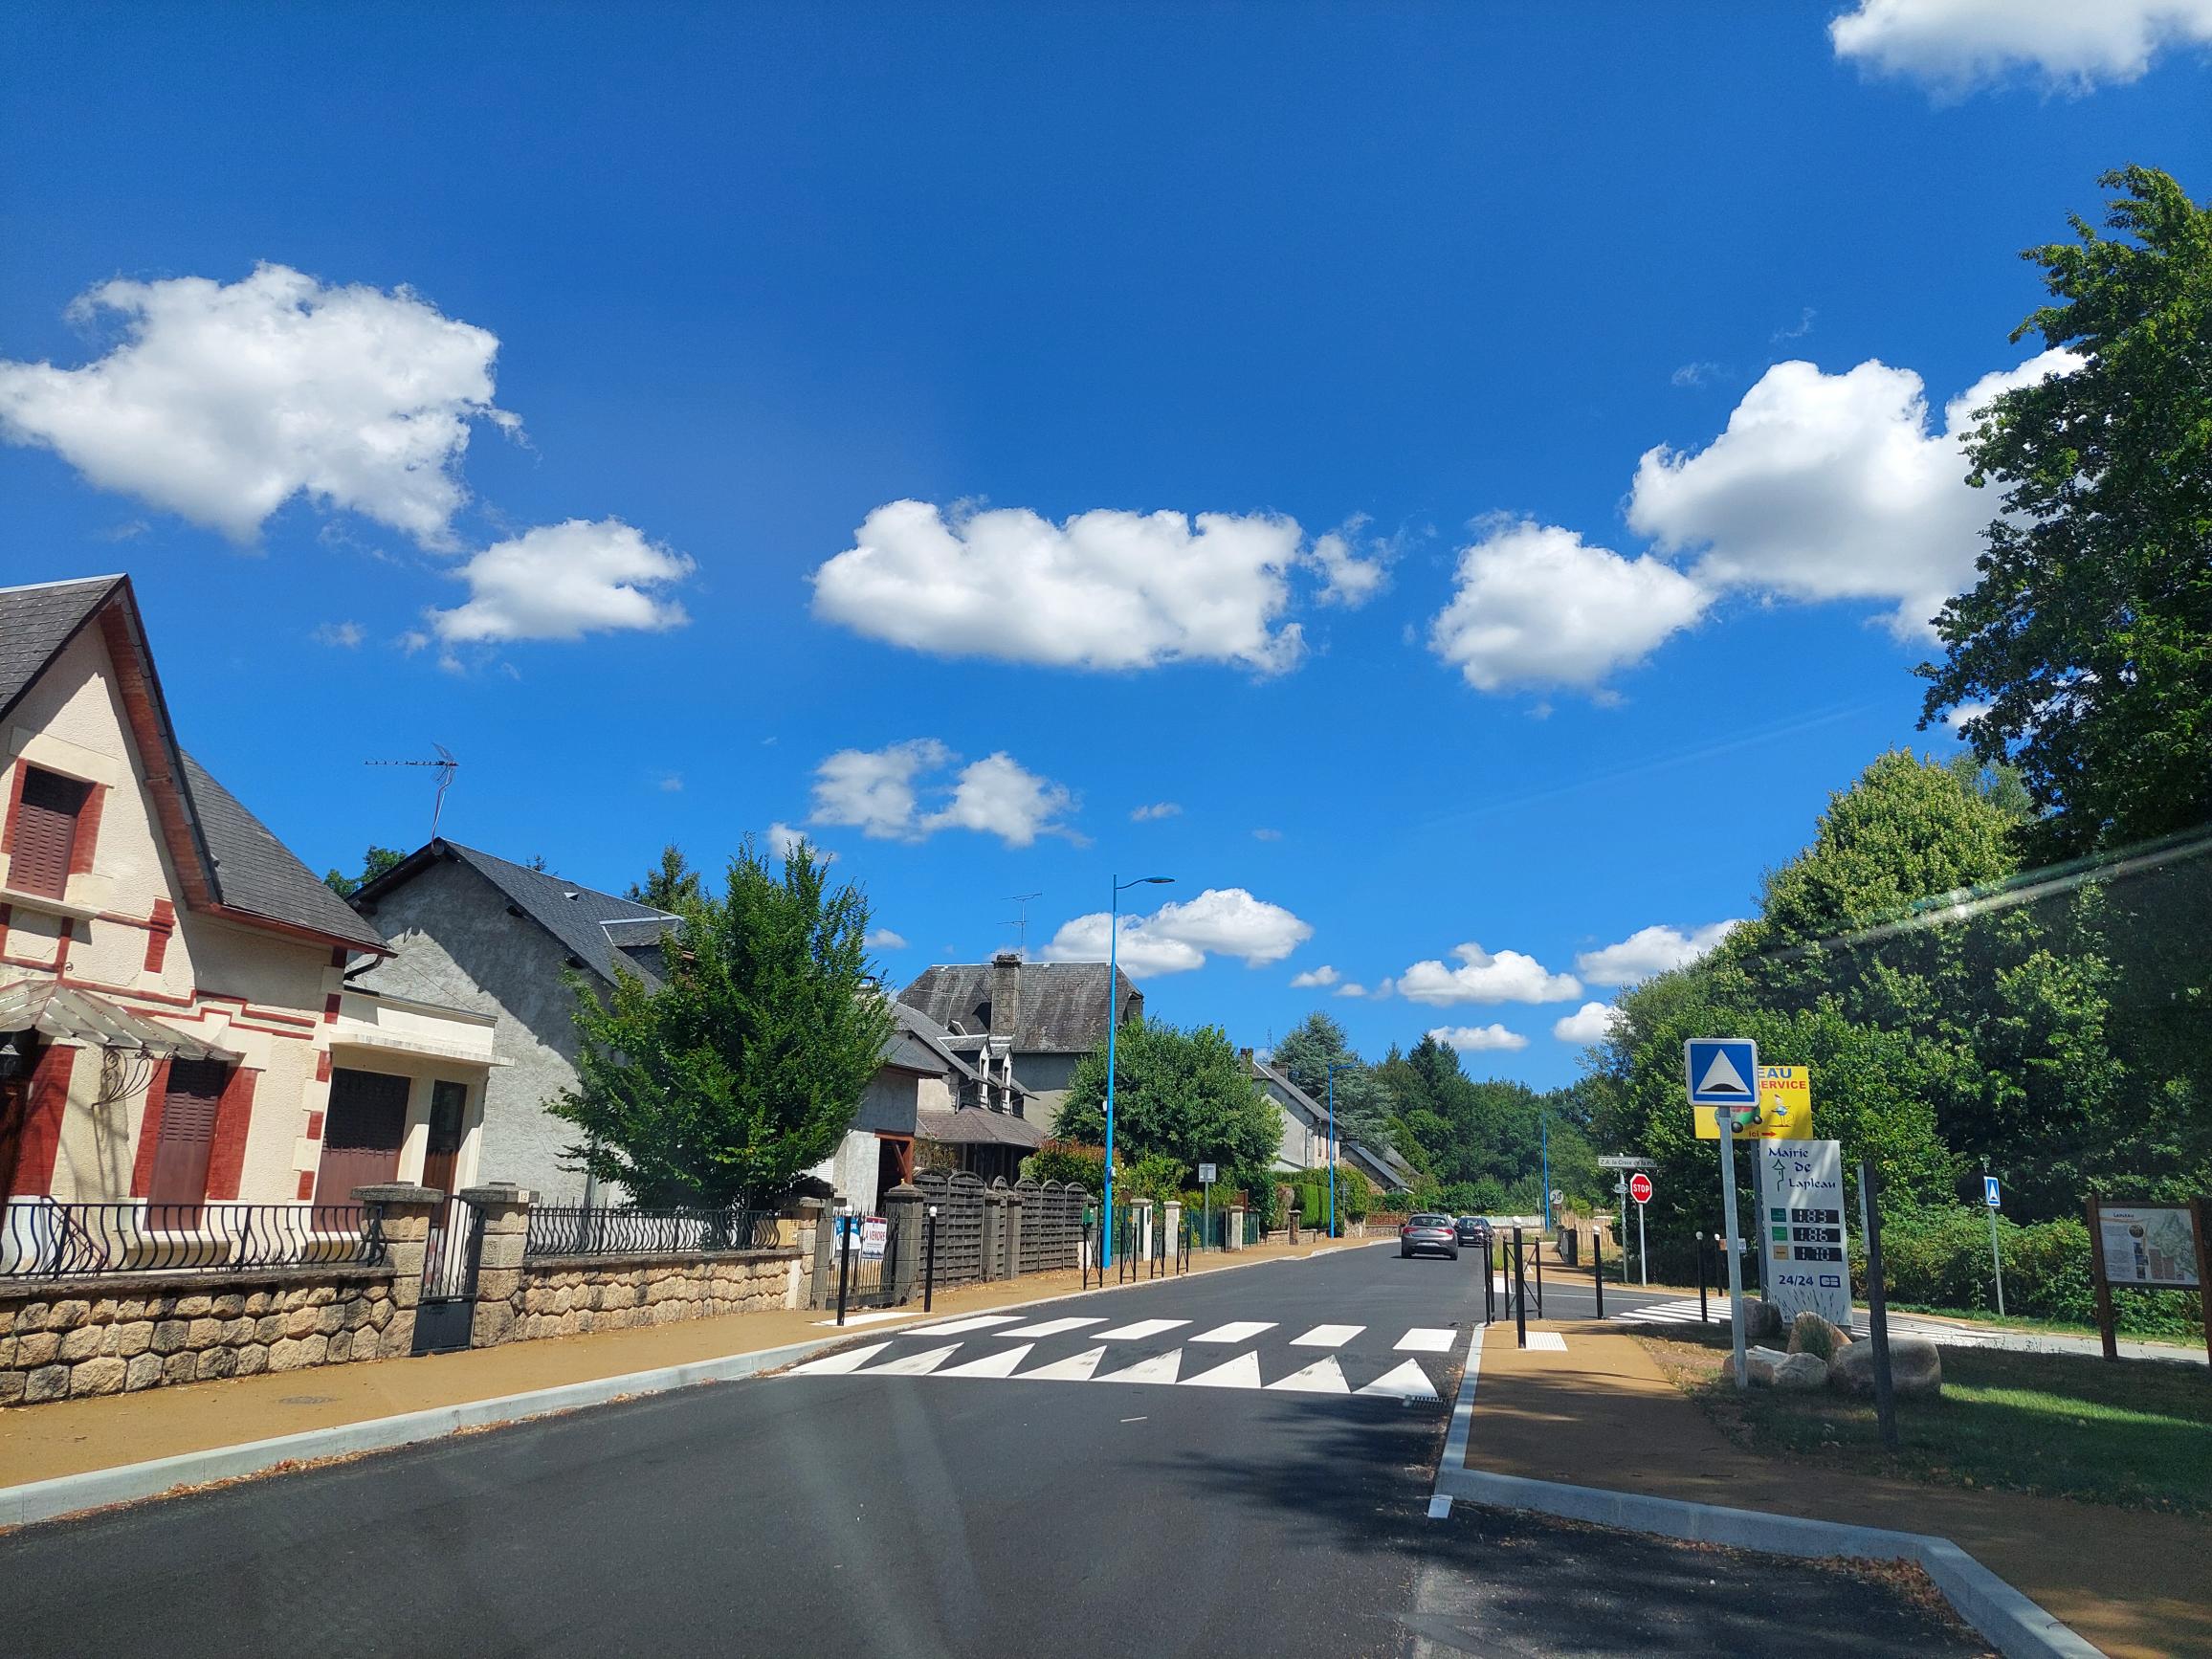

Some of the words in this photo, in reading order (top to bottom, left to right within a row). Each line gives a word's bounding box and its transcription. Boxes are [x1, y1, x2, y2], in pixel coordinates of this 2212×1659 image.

[1759, 1080, 1806, 1090] ERVICE
[1768, 1147, 1808, 1159] Mairie
[1794, 1161, 1811, 1173] de
[1633, 1183, 1650, 1193] STOP
[1788, 1178, 1836, 1190] Lapleau
[1799, 1209, 1827, 1224] 1.83
[1800, 1228, 1828, 1242] 1.86
[1802, 1247, 1829, 1261] 1.70
[1779, 1274, 1814, 1287] 24/24
